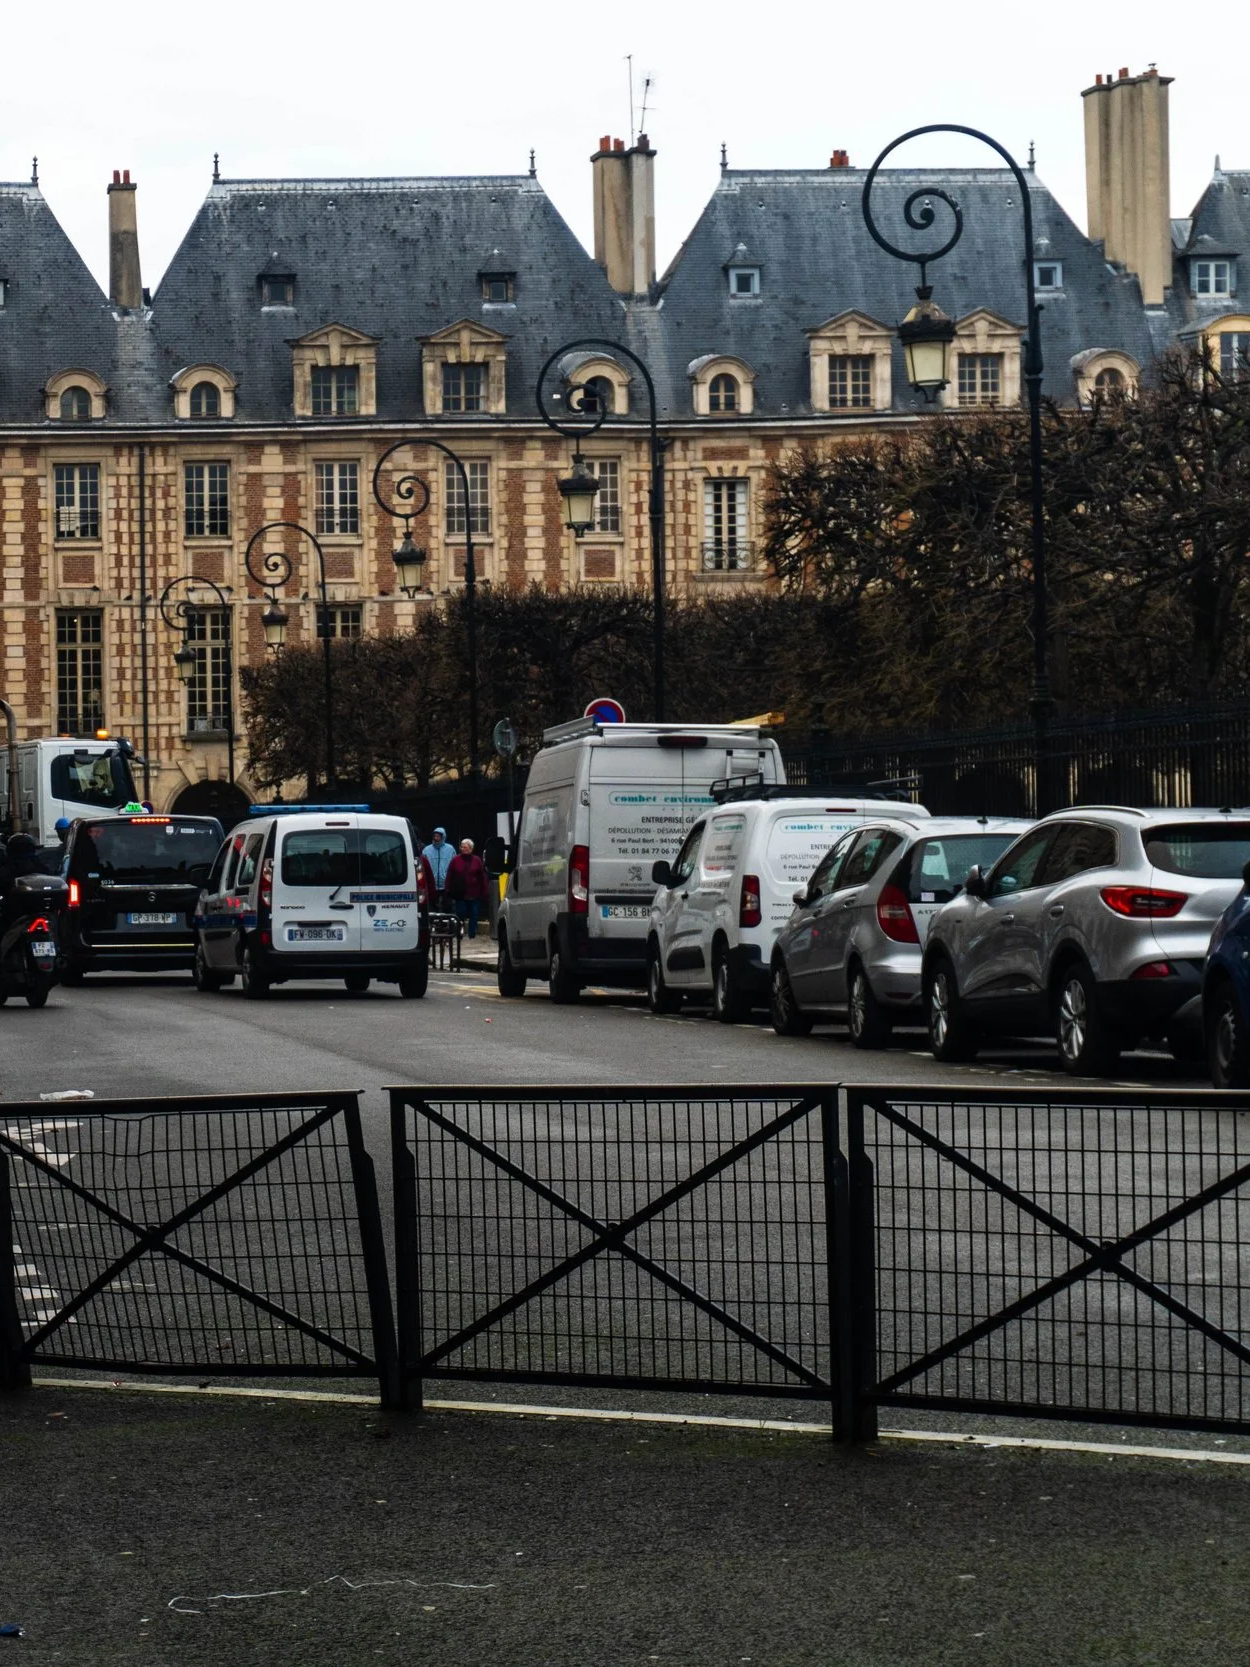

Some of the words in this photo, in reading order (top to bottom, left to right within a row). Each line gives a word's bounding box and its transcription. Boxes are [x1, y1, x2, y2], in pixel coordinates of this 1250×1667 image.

[614, 794, 657, 803] combet
[785, 823, 824, 831] combet
[376, 893, 415, 901] MUNICIPALE
